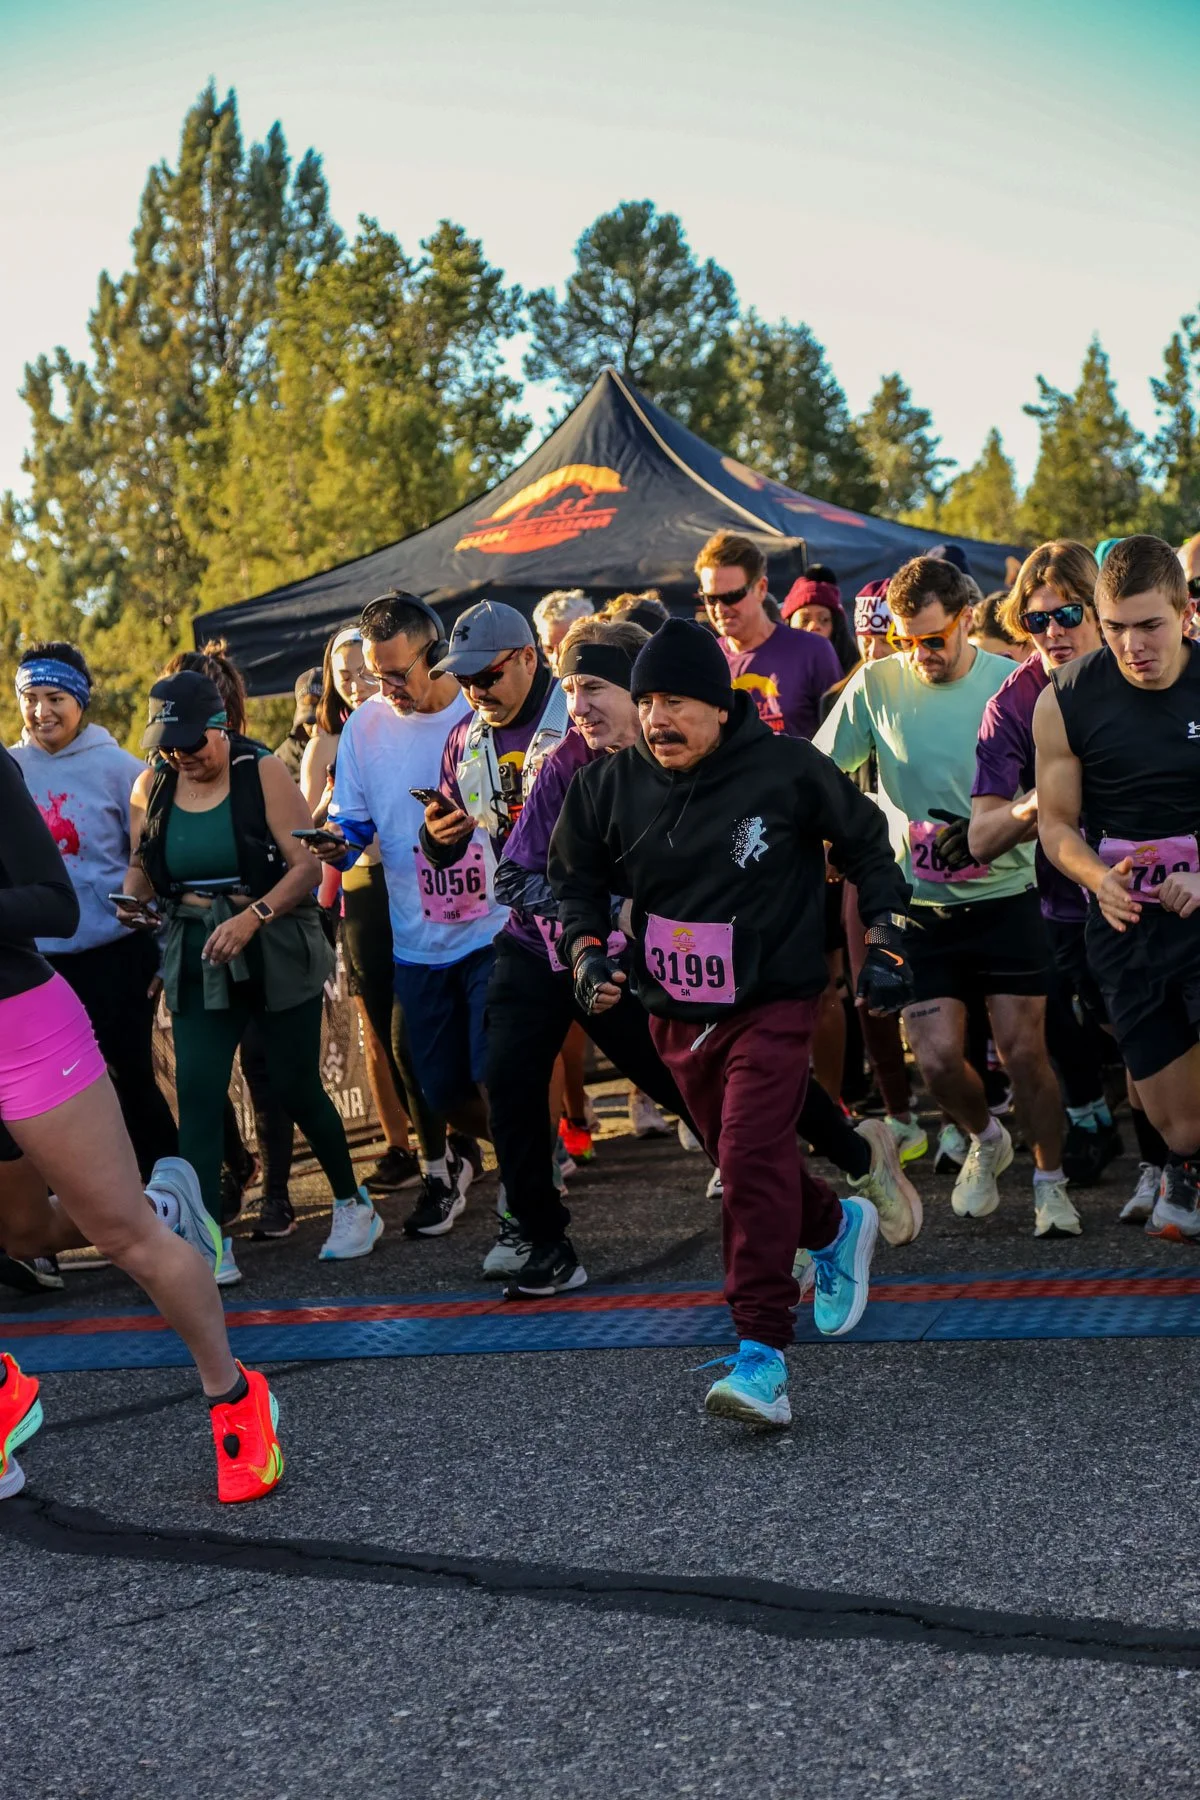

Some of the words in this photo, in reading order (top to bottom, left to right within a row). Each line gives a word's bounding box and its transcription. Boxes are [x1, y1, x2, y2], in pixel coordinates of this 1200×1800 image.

[421, 866, 481, 896] 3056
[443, 910, 461, 920] 3056
[651, 947, 726, 989] 3199
